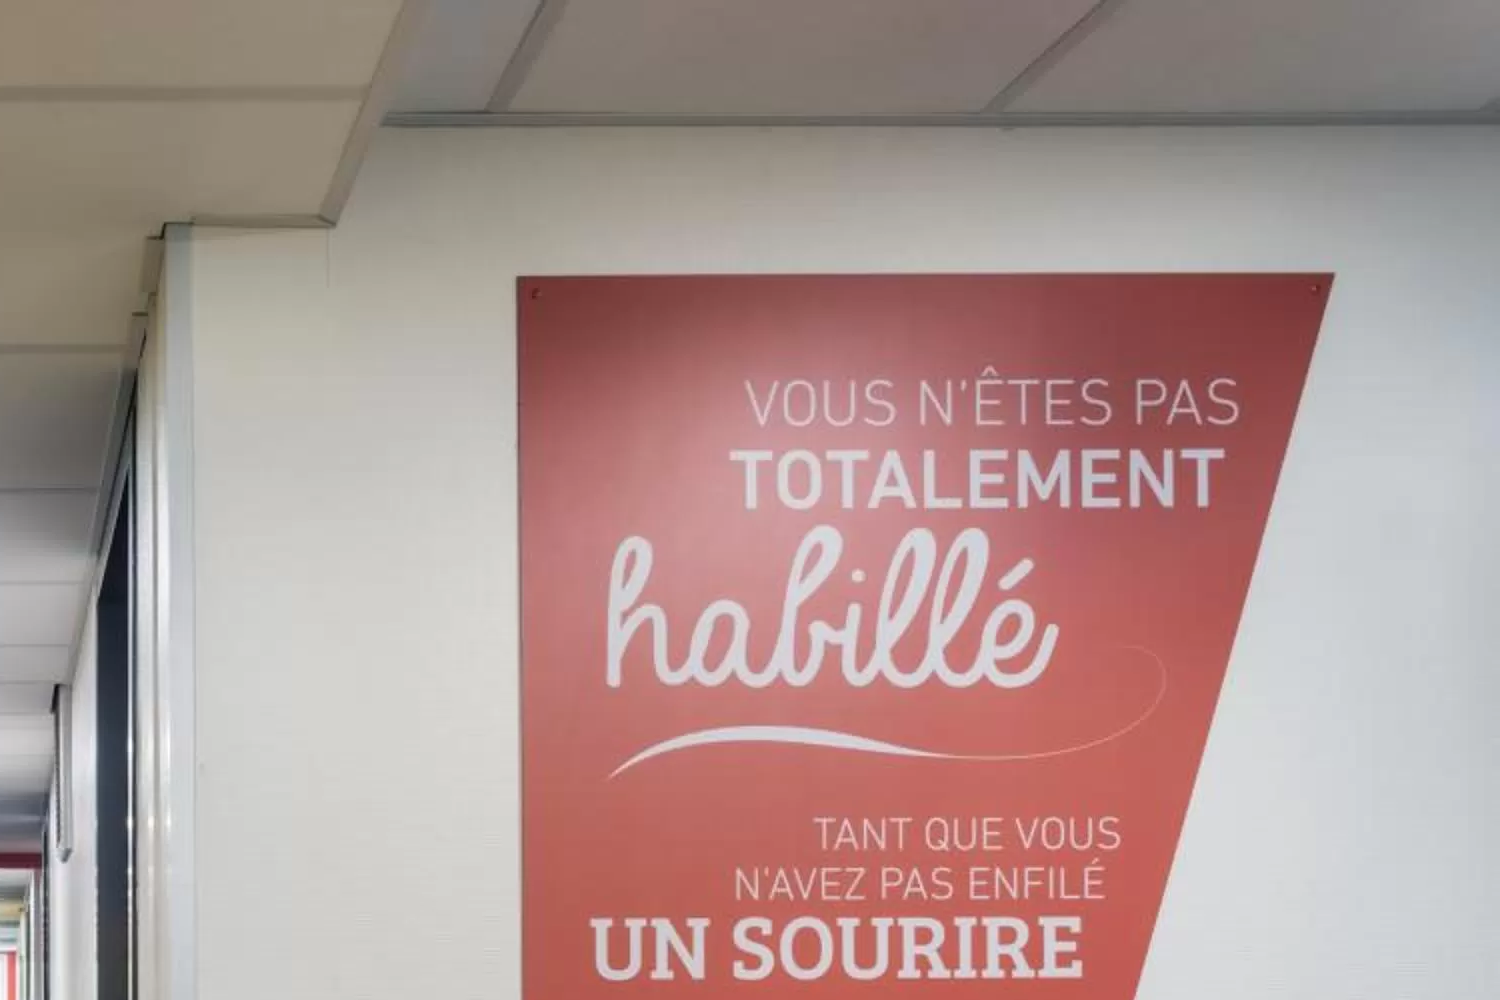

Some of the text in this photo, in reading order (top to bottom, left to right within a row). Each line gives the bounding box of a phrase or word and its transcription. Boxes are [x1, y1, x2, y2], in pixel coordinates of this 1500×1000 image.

[745, 366, 1241, 427] VOUS N'ÊTES PAS
[729, 448, 1226, 509] TOTALEMENT
[606, 524, 1060, 688] habillé
[813, 816, 1122, 854] TANT QUE VOUS
[735, 857, 1106, 901] N'AVEZ PAS ENFILÉ
[590, 916, 1084, 981] UN SOURIRE
